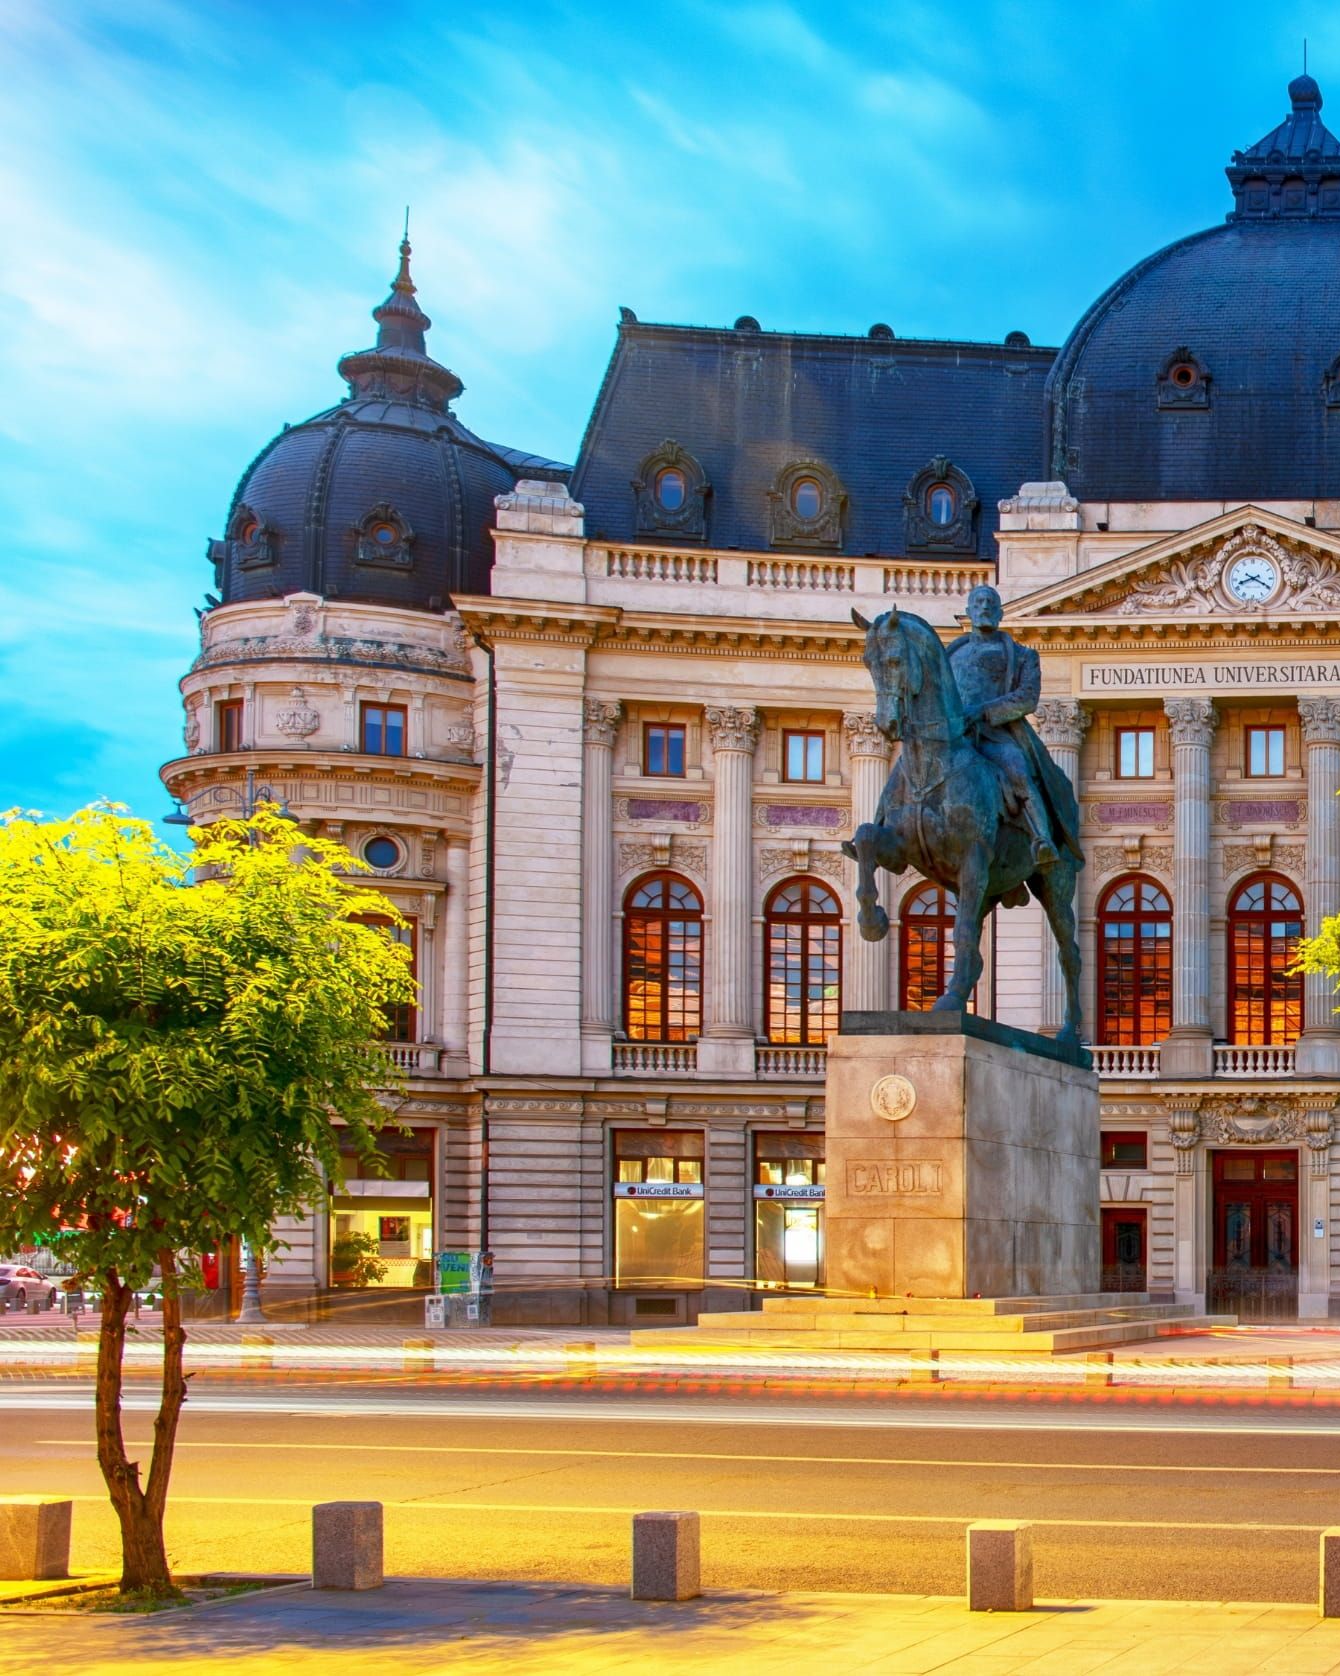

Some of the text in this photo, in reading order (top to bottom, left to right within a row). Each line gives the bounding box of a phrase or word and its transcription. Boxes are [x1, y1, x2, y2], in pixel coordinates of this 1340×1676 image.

[1089, 666, 1206, 685] FUNDATIUNEA
[1213, 664, 1340, 683] UNIVERSITARA
[853, 1163, 927, 1193] CAROL
[637, 1186, 692, 1196] UniCredit Bank
[775, 1188, 808, 1197] UniCredit
